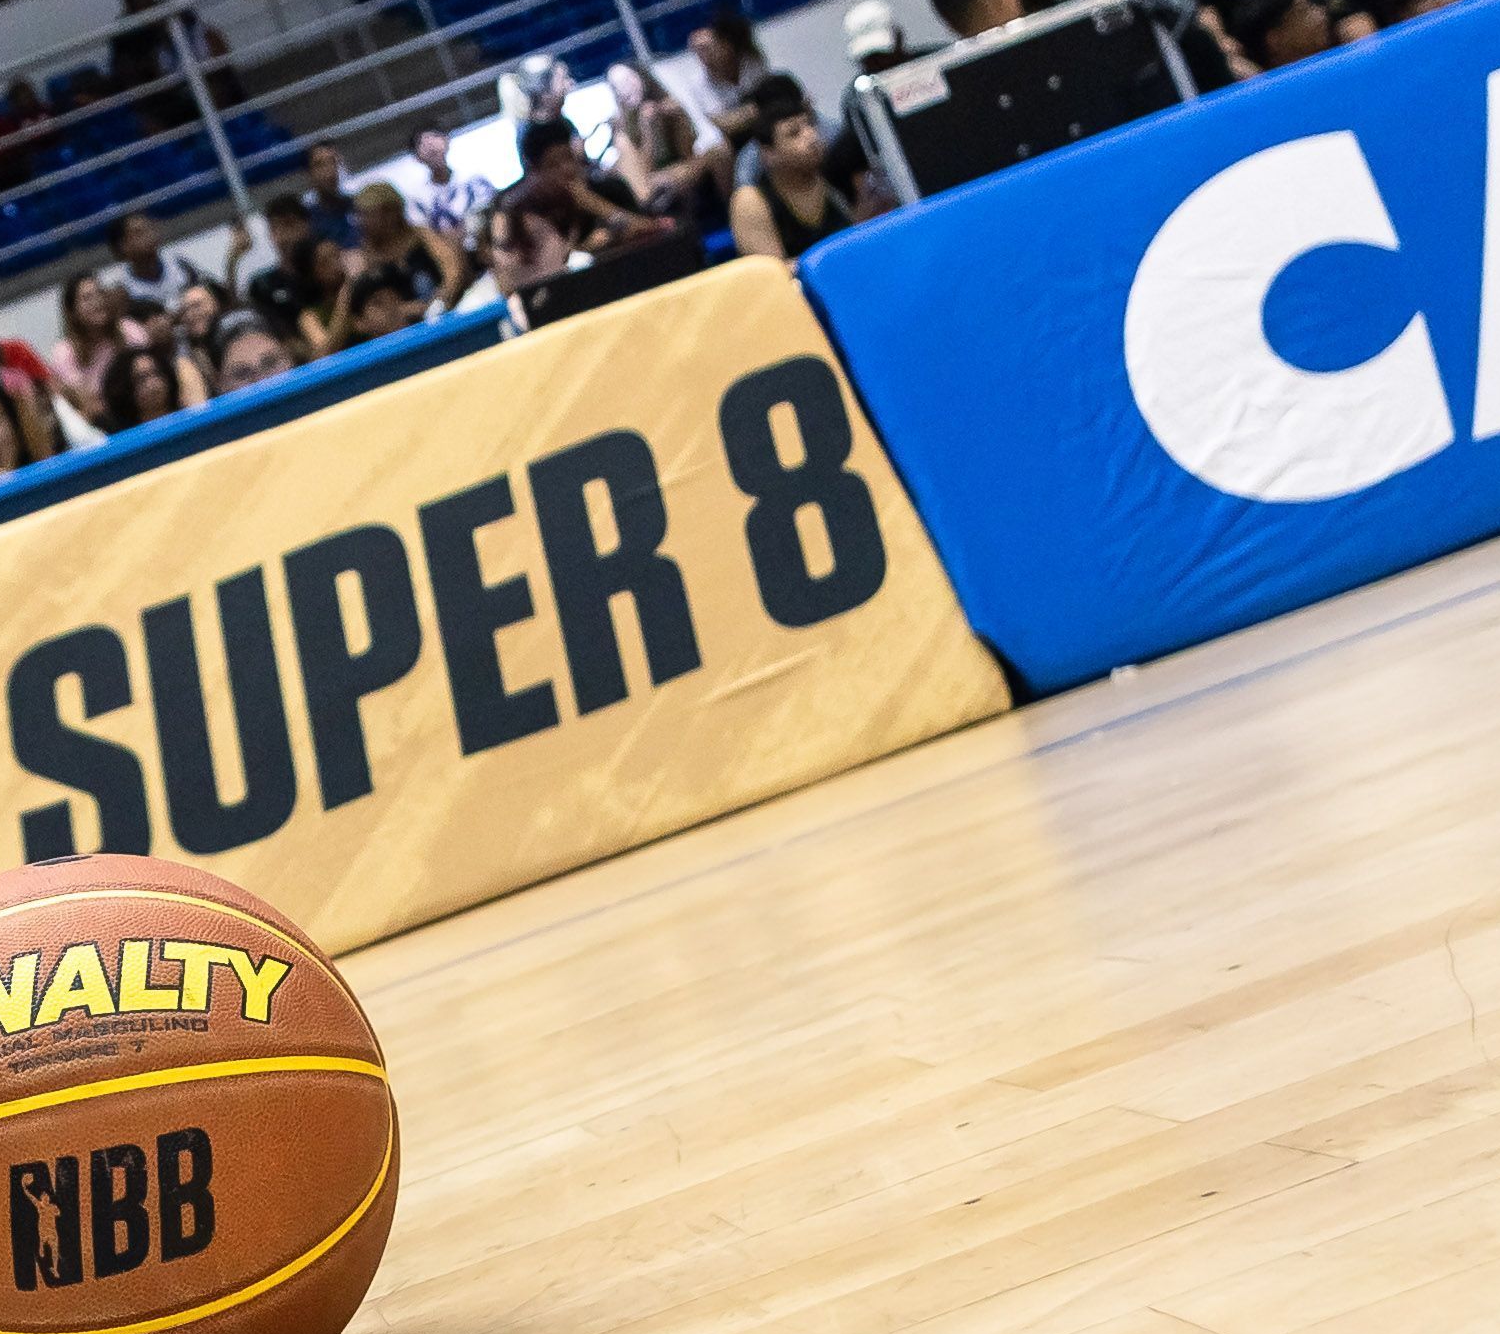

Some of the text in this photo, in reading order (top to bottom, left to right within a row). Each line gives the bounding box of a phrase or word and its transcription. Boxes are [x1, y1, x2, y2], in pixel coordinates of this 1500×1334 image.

[6, 426, 703, 858] SUPER
[717, 352, 888, 629] 8
[9, 1126, 216, 1293] NBB
